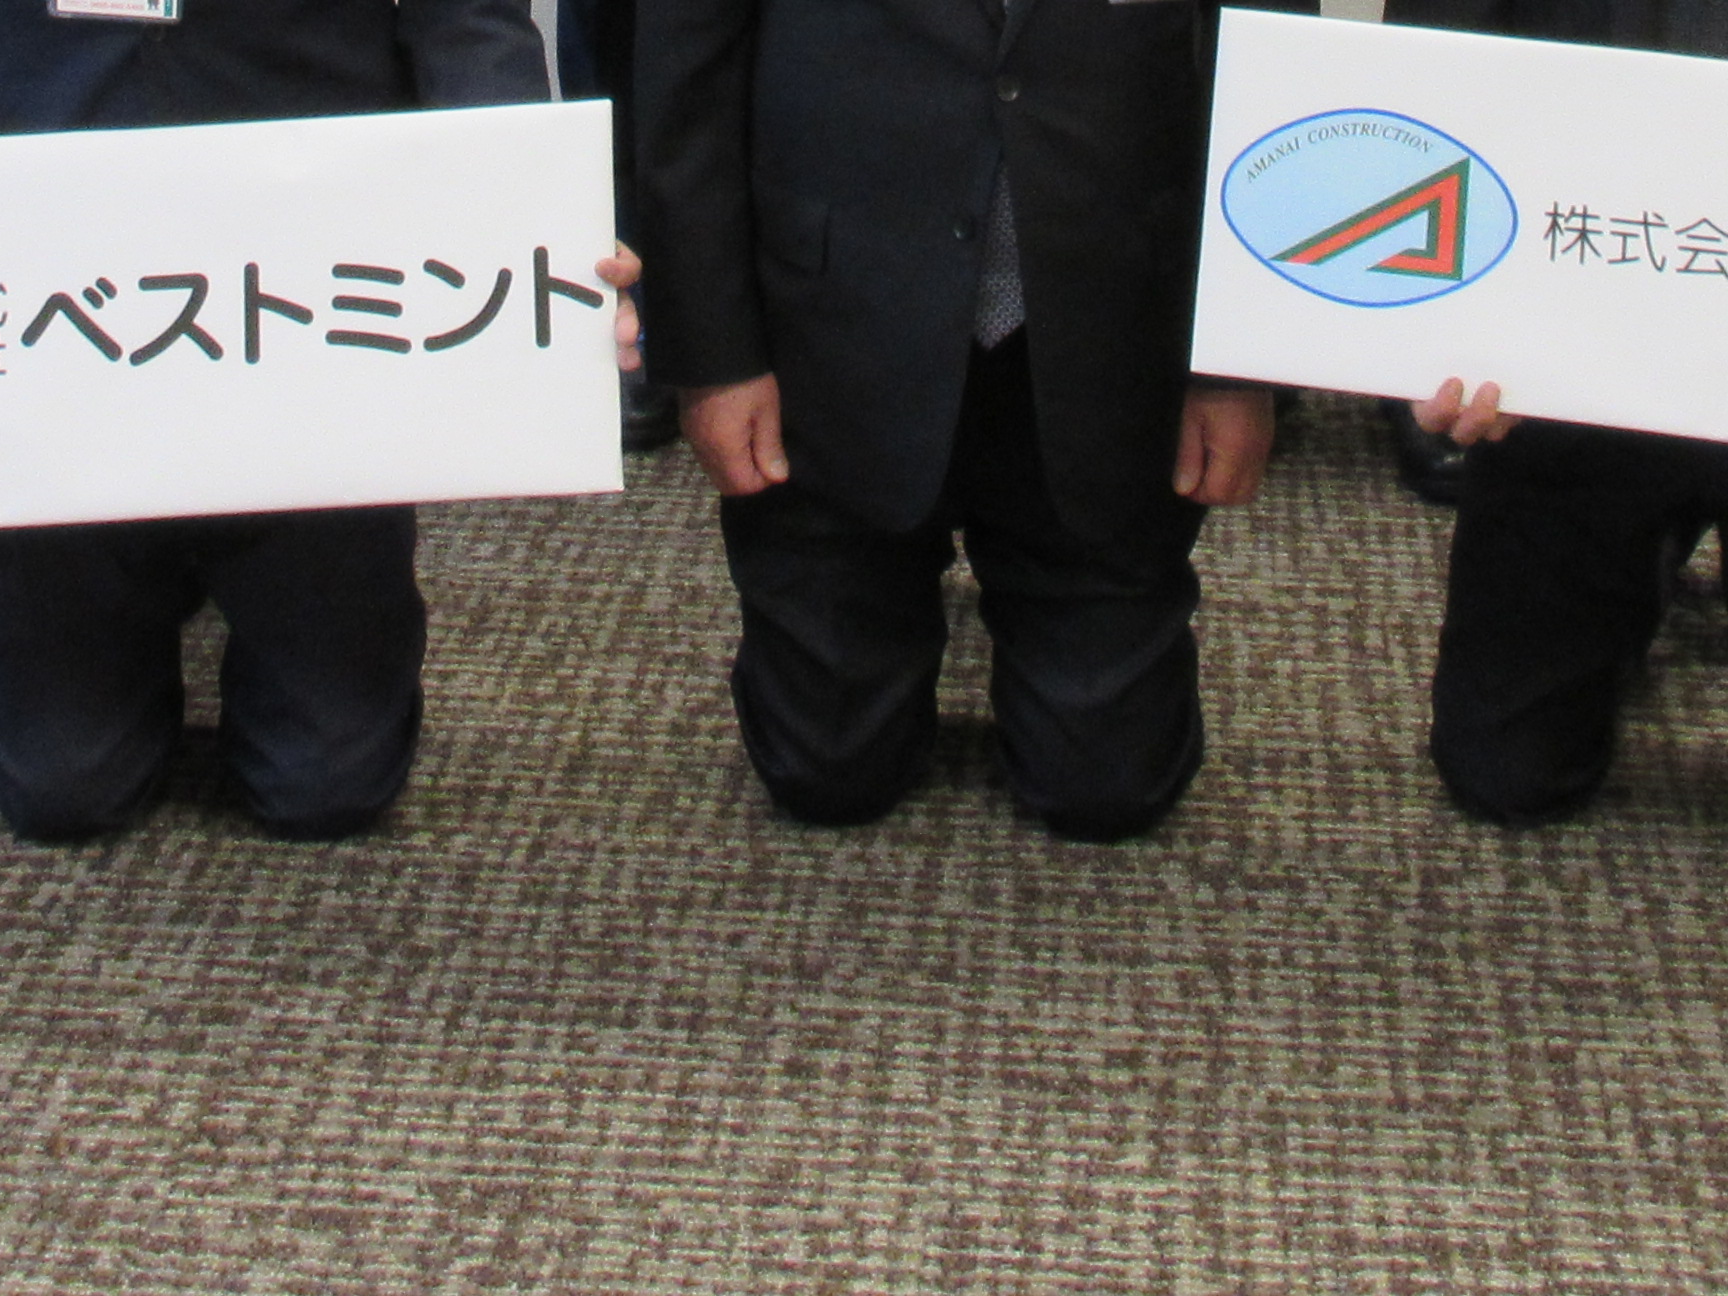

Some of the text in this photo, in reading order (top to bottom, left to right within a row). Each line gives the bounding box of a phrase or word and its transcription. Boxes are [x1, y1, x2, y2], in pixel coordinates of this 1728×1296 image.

[1245, 122, 1434, 184] AMANAI CONSTRUCTION
[19, 244, 605, 368] ベストミント
